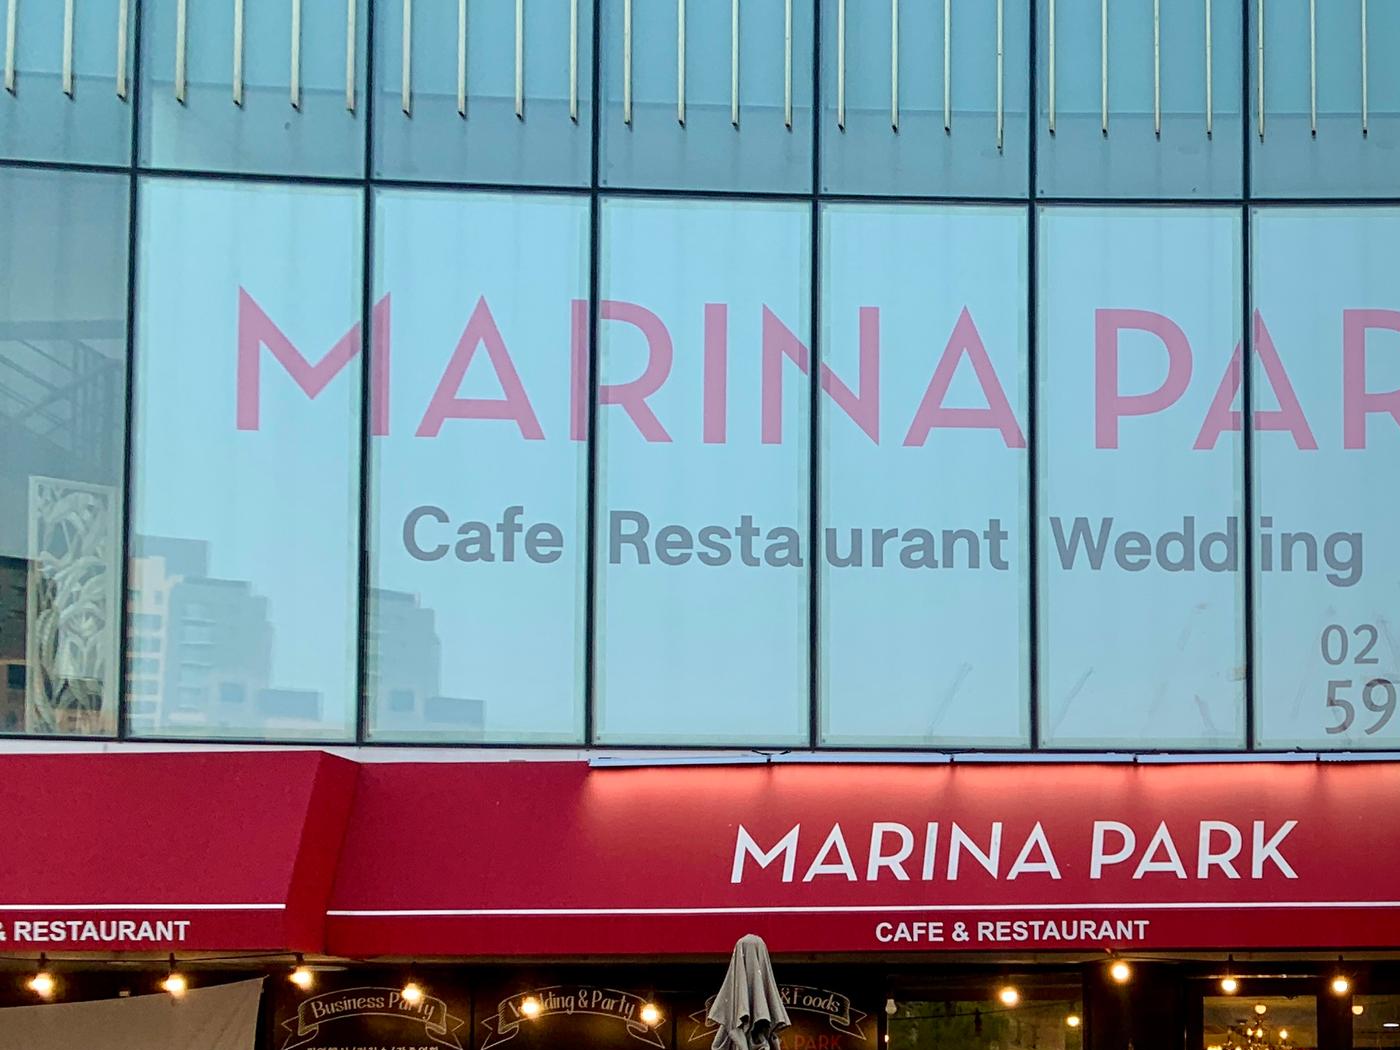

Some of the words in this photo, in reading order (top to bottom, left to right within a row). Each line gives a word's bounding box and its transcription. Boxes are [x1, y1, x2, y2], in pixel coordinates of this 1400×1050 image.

[236, 286, 1028, 448] MARINA
[402, 505, 565, 562] Cafe
[608, 510, 1010, 570] Restaurant
[1049, 516, 1364, 588] Wedding
[1320, 623, 1381, 666] 02
[730, 821, 1063, 884] MARINA
[1089, 820, 1299, 880] PARK
[13, 920, 190, 942] RESTAURANT
[875, 922, 943, 943] CAFE
[952, 921, 970, 942] &
[977, 920, 1149, 942] RESTAURANT
[311, 996, 385, 1020] Business
[578, 988, 590, 1009] &
[591, 990, 636, 1021] Party
[793, 987, 841, 1013] Foods
